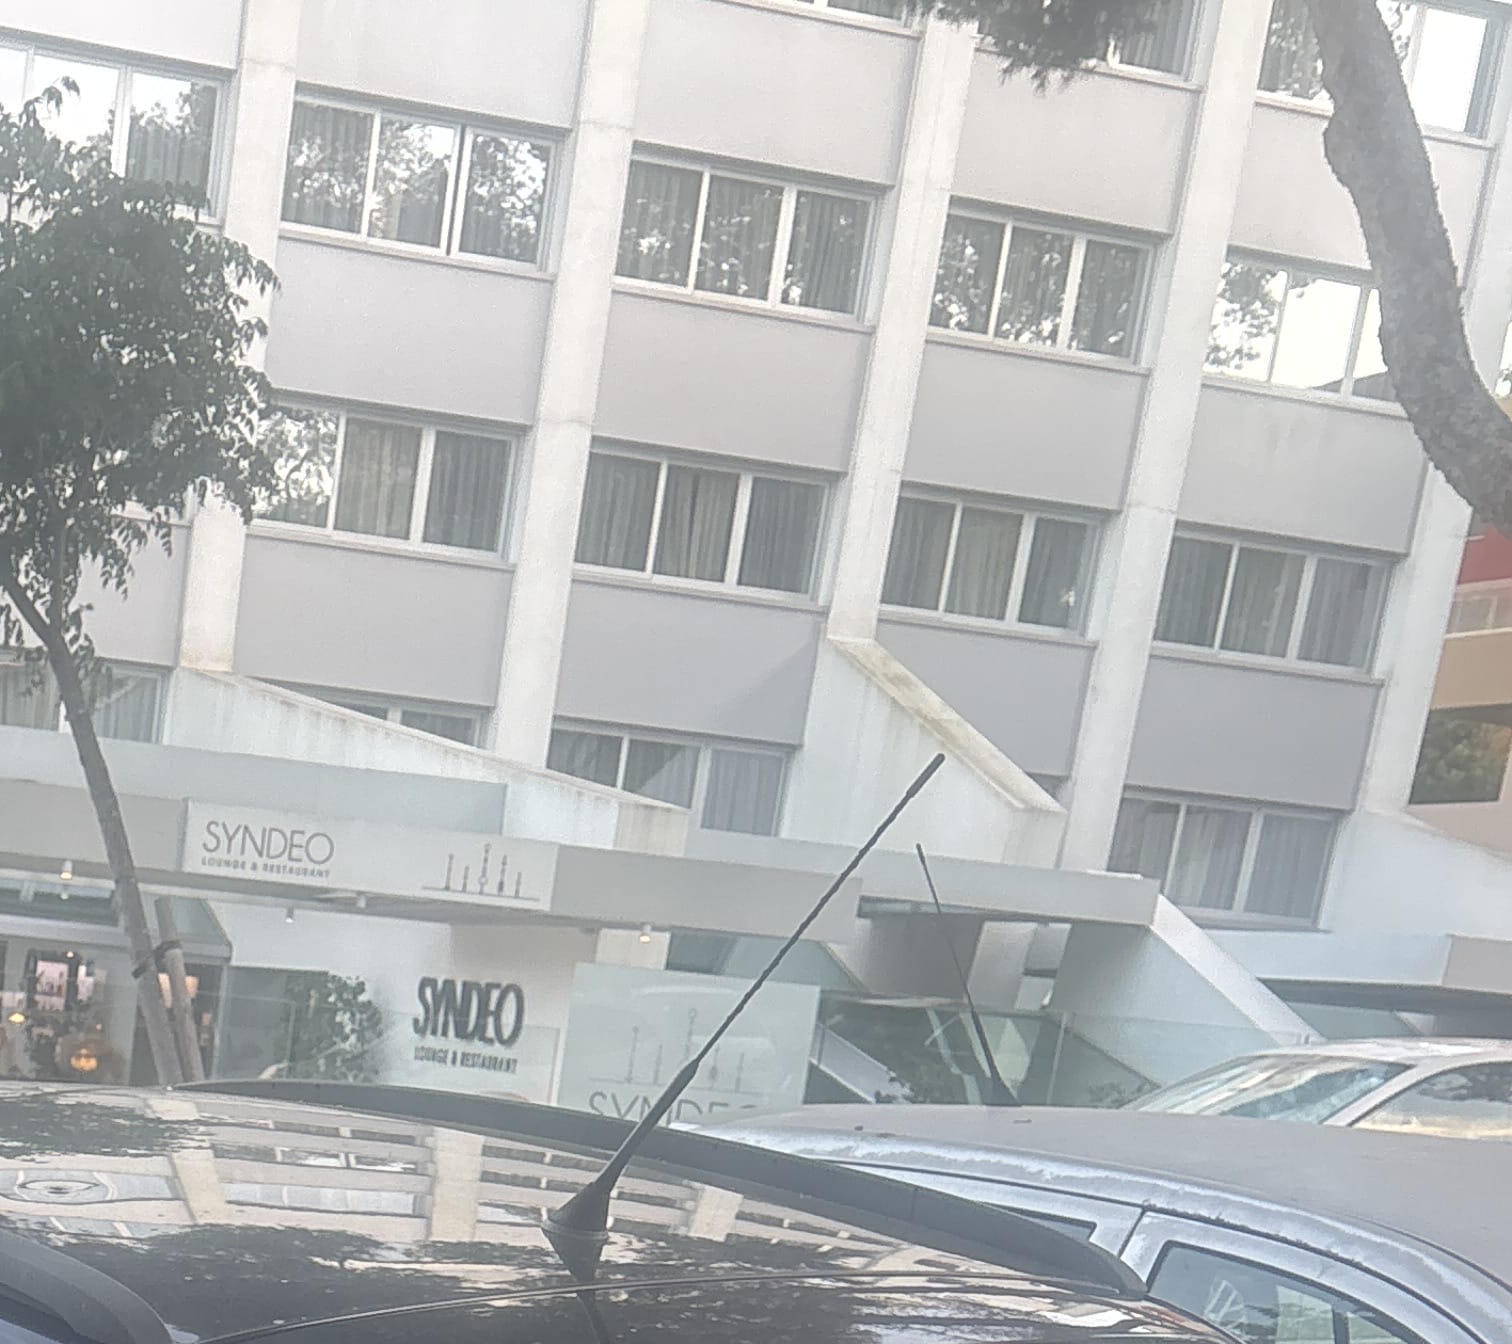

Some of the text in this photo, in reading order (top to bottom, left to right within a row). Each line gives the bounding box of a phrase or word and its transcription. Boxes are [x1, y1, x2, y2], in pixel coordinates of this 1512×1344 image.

[201, 820, 336, 865] SYNDEO
[200, 856, 247, 871] LOUNGE
[261, 863, 331, 879] RESTAURANT
[411, 976, 526, 1049] SYNDEO
